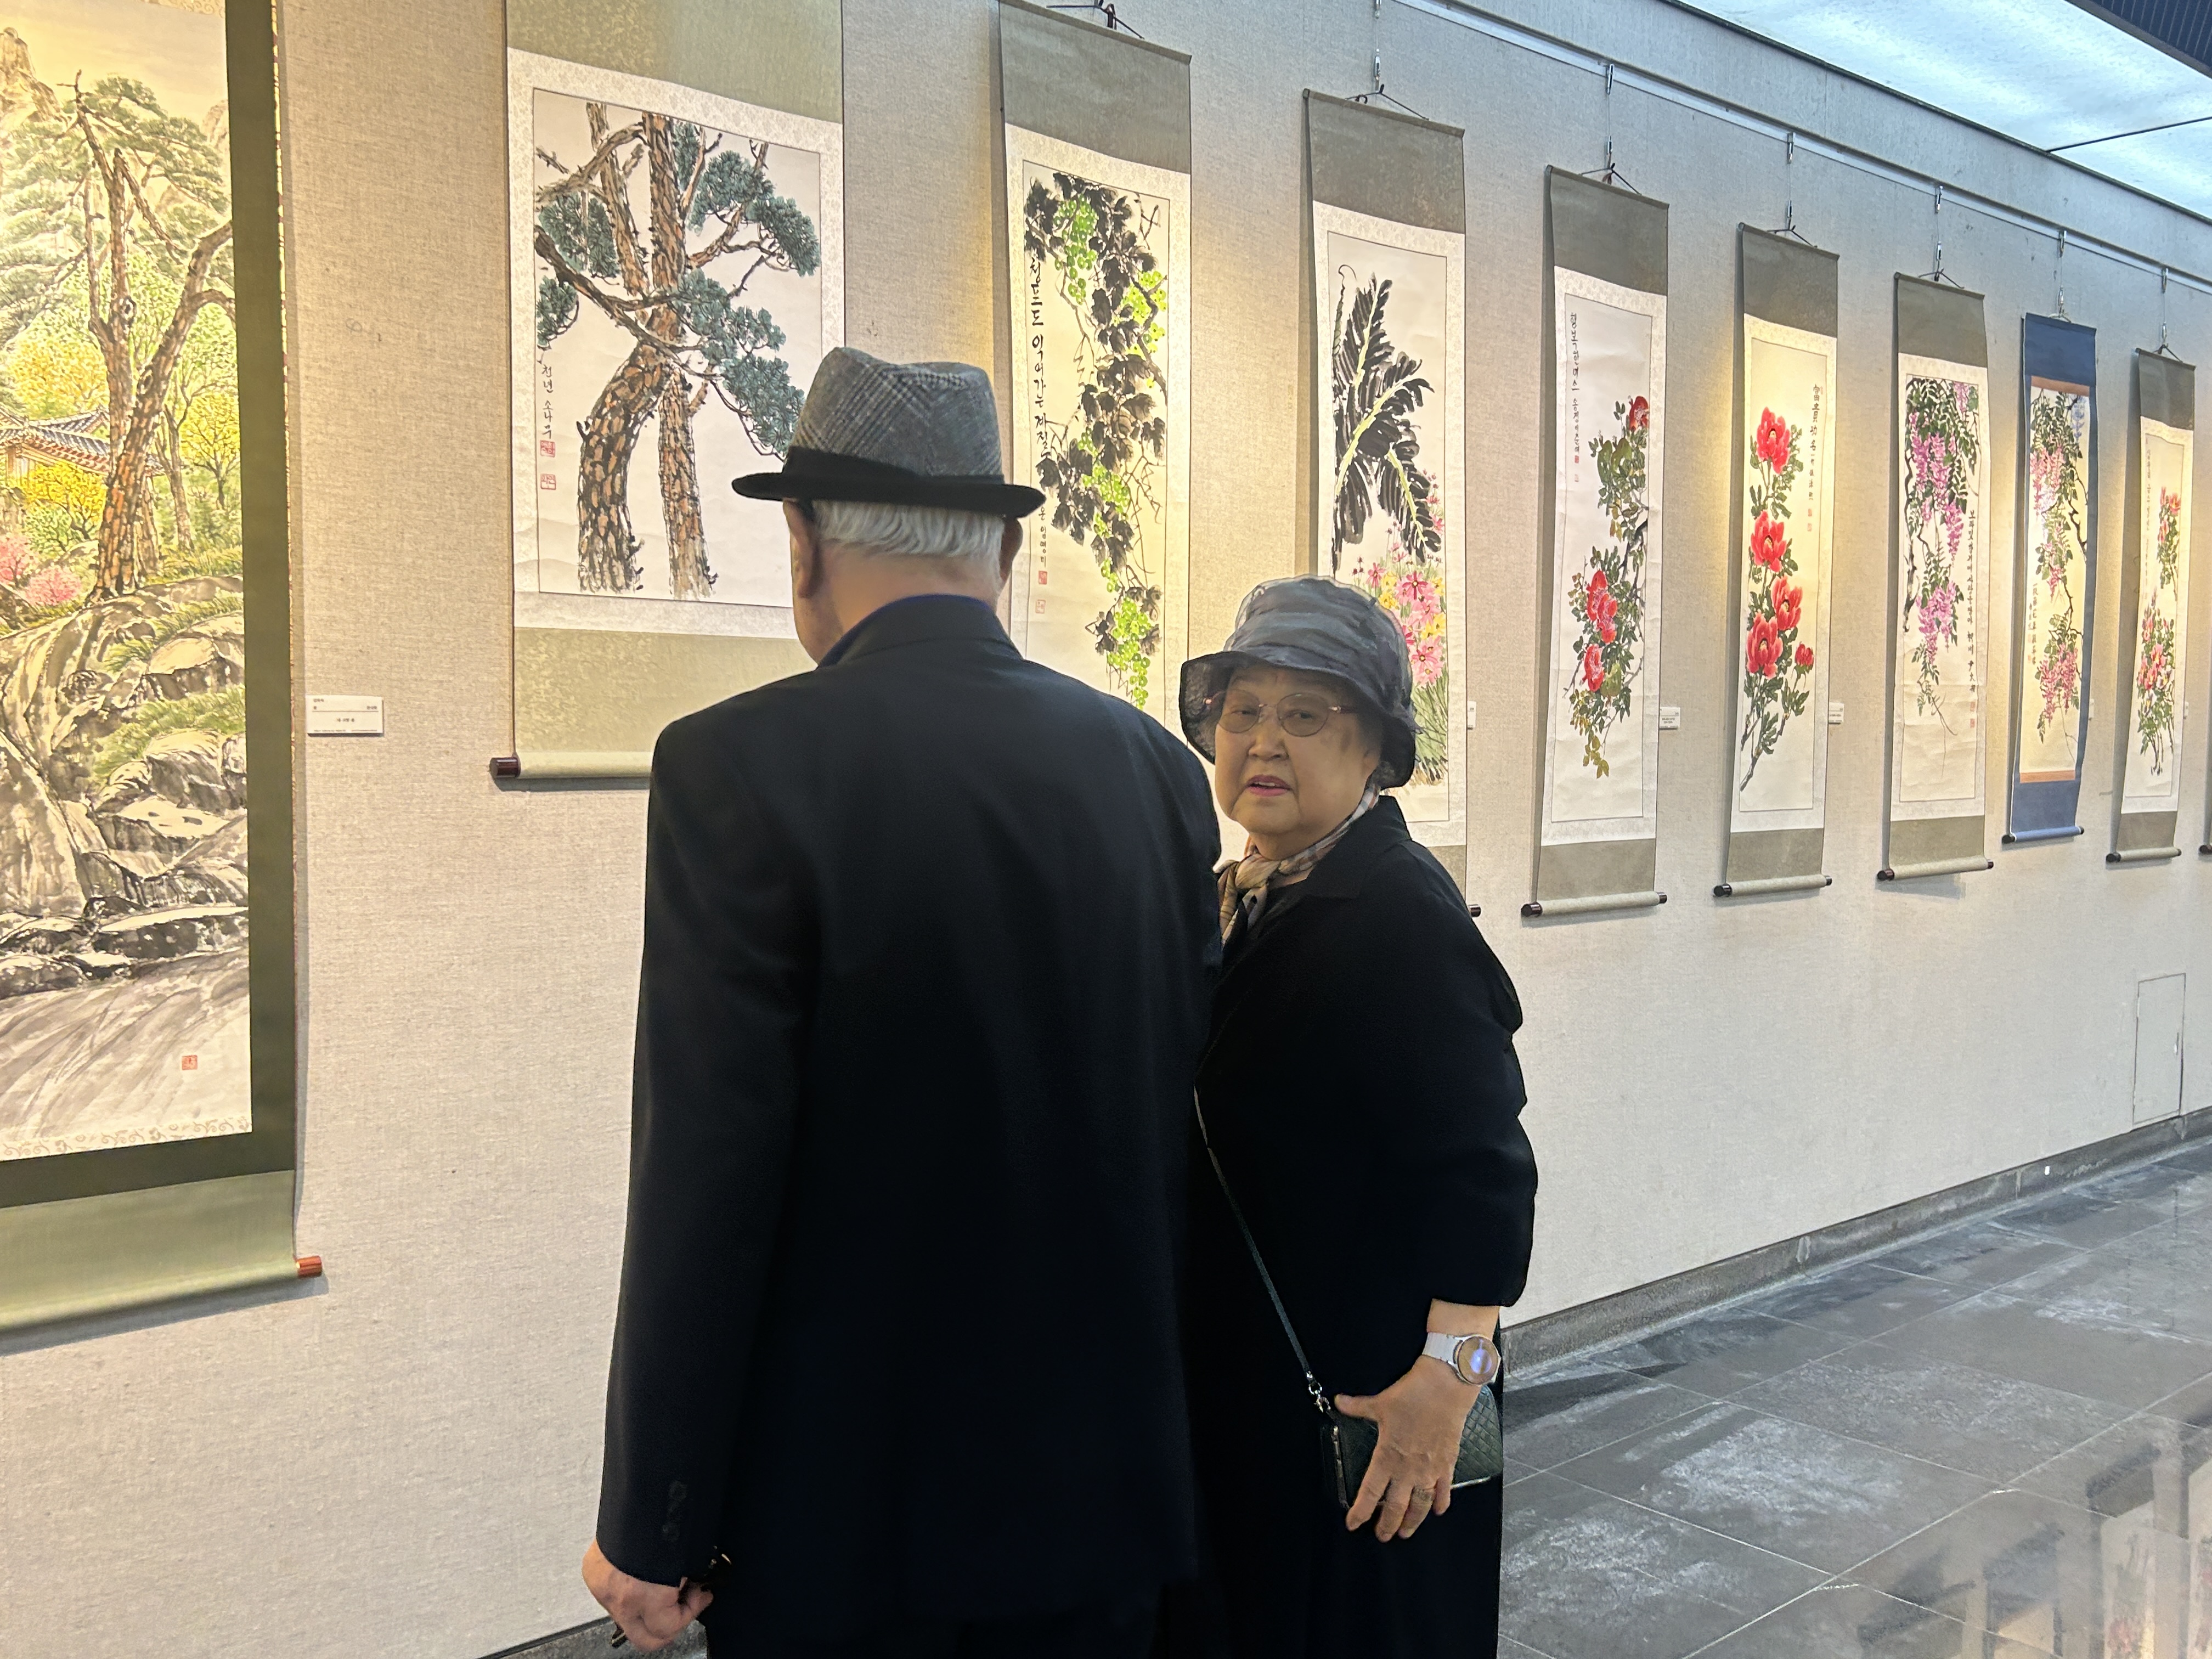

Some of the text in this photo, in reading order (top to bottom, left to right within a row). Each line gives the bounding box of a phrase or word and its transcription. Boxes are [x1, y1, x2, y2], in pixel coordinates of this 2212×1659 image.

[541, 365, 553, 393] 천년
[1032, 334, 1046, 408] 익어가는
[542, 400, 553, 439] 소나무
